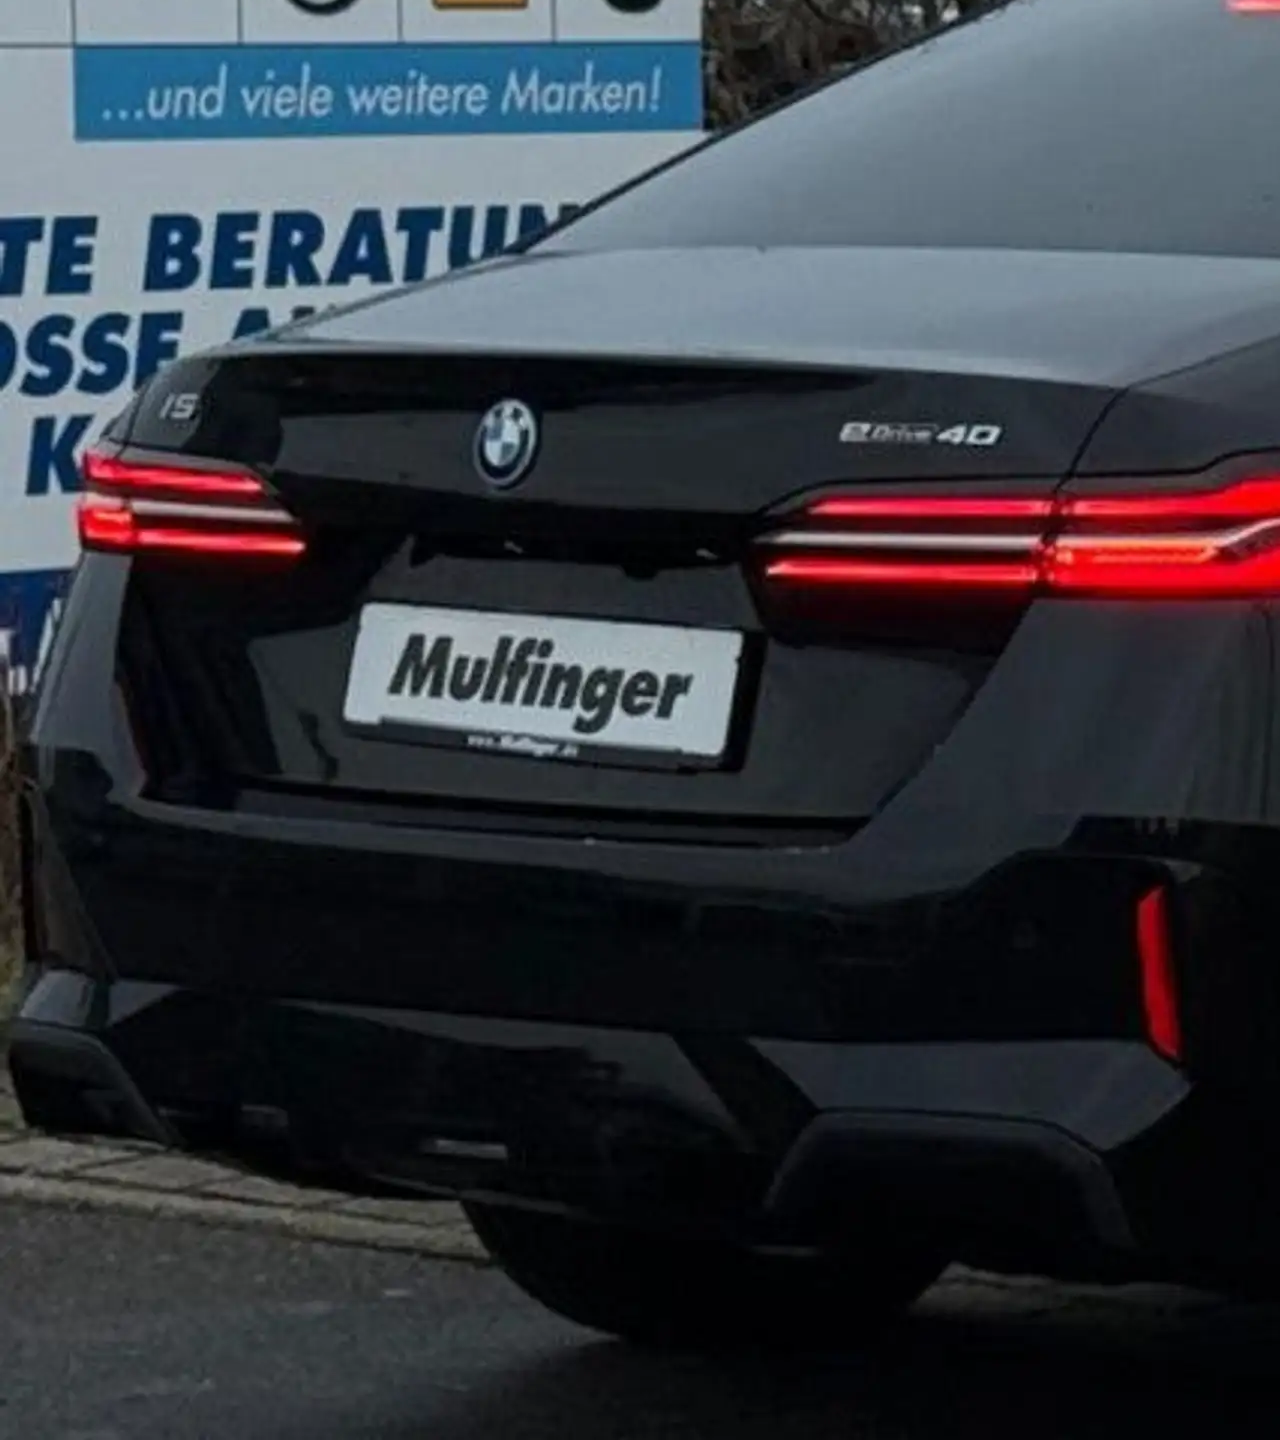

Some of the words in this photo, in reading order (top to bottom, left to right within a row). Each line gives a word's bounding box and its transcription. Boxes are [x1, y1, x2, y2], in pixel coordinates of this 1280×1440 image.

[241, 62, 334, 119] viele
[347, 70, 490, 117] weitere
[500, 63, 664, 115] Marken!
[387, 633, 694, 735] Mulfinger
